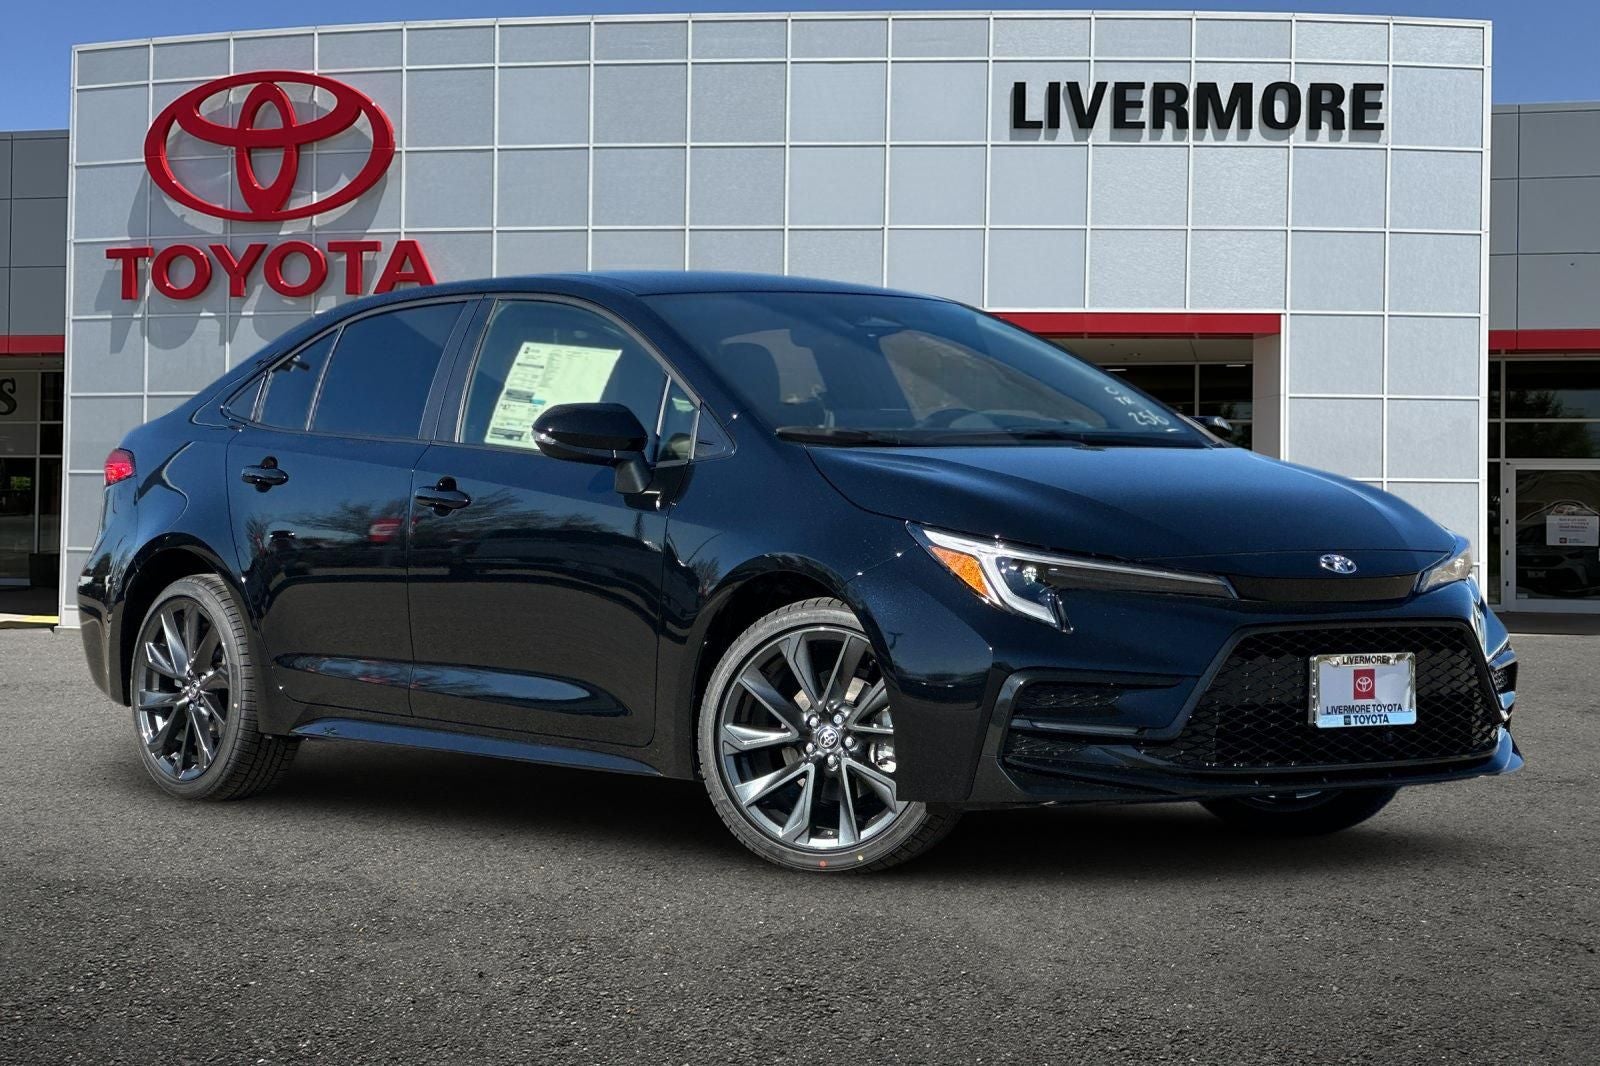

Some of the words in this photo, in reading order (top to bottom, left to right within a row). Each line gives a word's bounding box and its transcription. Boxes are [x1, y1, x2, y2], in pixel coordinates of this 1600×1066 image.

[1013, 81, 1385, 131] LIVERMORE
[105, 239, 437, 301] TOYOTA
[1342, 655, 1387, 665] LIVERMORE
[1326, 704, 1371, 715] LIVERMORE
[1372, 703, 1403, 713] TOYOTA
[1353, 713, 1390, 725] TOYOTA
